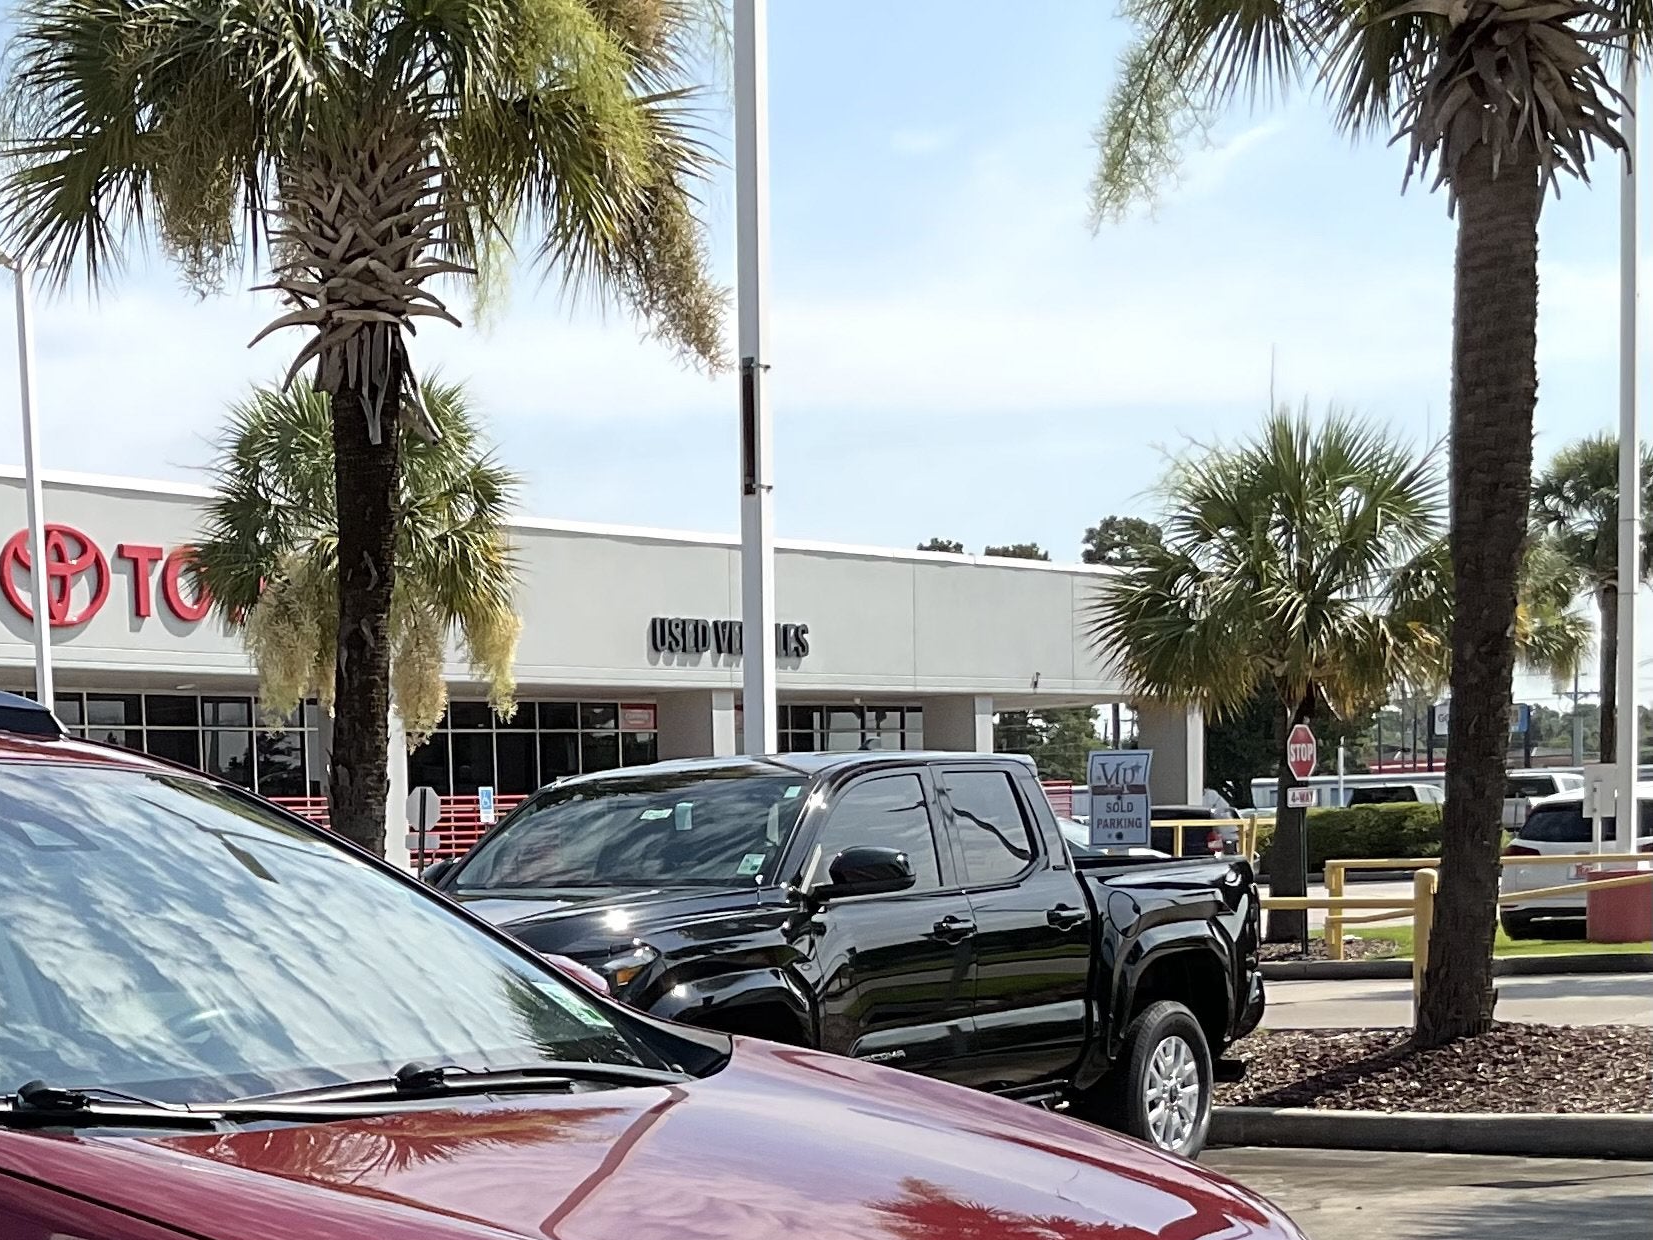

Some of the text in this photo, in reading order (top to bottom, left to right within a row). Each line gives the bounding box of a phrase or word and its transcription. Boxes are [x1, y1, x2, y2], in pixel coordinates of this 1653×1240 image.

[117, 543, 256, 626] TO
[651, 617, 810, 658] USED VELES
[1290, 743, 1314, 762] STOP
[1105, 800, 1134, 814] SOLD
[1096, 817, 1143, 830] PARKING
